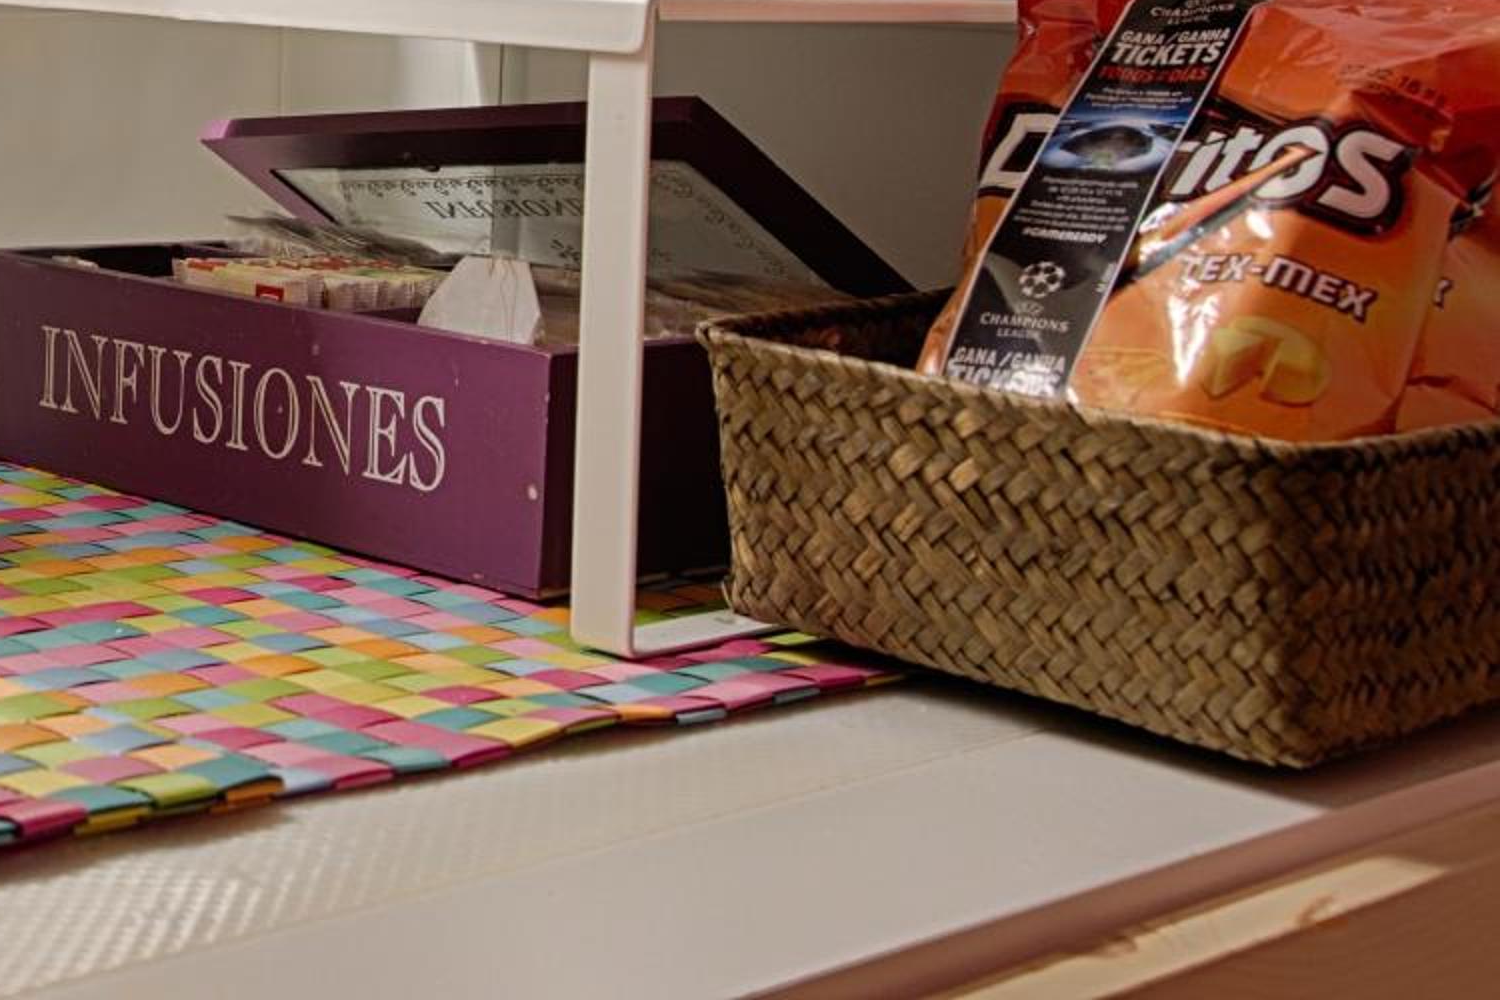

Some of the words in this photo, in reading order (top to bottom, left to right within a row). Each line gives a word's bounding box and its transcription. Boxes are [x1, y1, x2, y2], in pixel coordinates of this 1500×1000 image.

[1111, 42, 1225, 66] TICKETS
[1182, 252, 1377, 322] TEX-MEX
[980, 311, 1070, 333] CHAMPIONS
[39, 325, 446, 491] INFUSIONES
